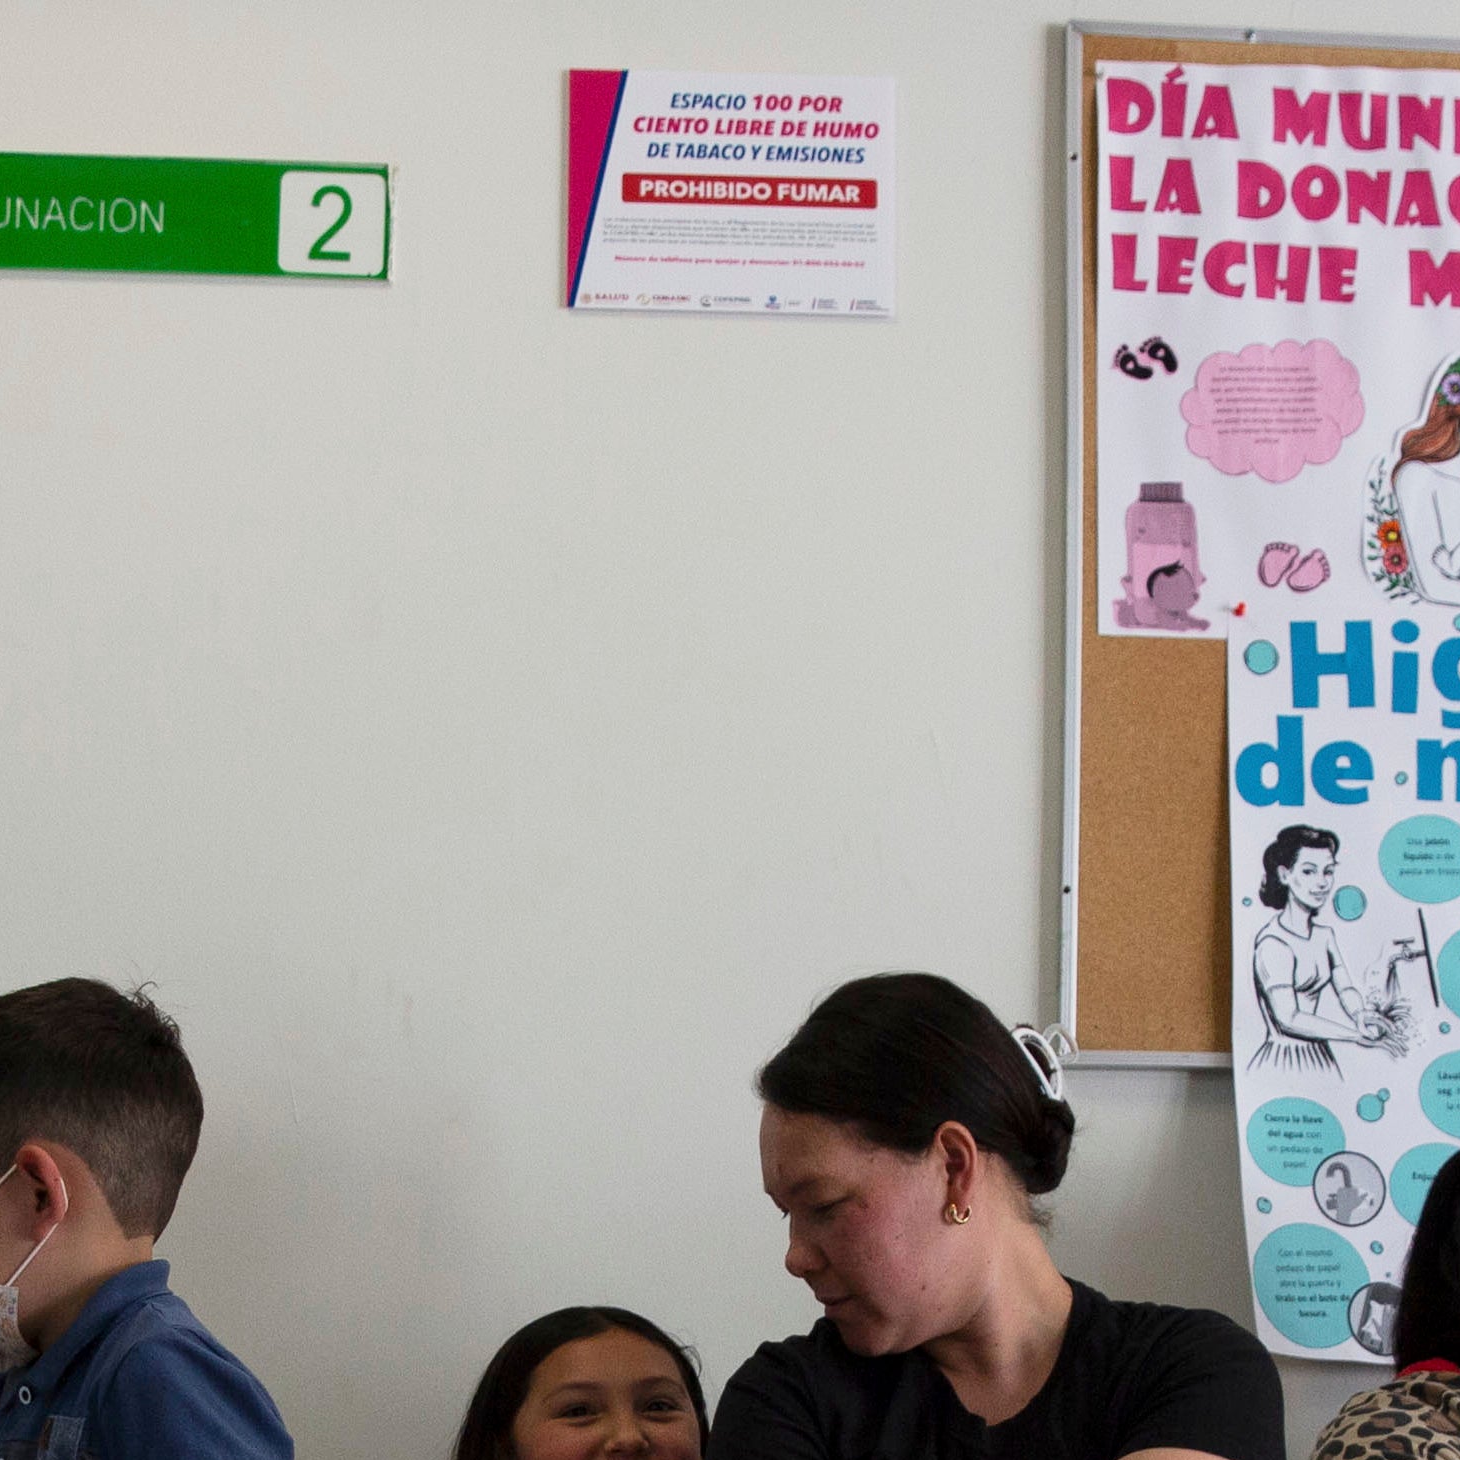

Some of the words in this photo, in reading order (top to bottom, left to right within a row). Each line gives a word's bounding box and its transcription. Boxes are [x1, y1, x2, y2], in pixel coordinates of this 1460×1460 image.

[633, 117, 708, 135] CIENTO
[715, 119, 774, 136] LIBRE
[779, 121, 807, 137] DE
[813, 121, 879, 139] HUMO
[671, 93, 746, 110] ESPACIO
[753, 95, 792, 111] 100
[798, 96, 842, 113] POR
[1106, 66, 1239, 141] DÍA
[647, 142, 671, 158] DE
[677, 143, 745, 160] TABACO
[751, 145, 762, 160] Y
[766, 146, 865, 163] EMISIONES
[640, 179, 771, 201] PROHIBIDO
[778, 181, 860, 203] FUMAR
[1109, 156, 1202, 215] LA
[308, 185, 353, 261] 2
[1111, 234, 1357, 303] LECHE
[1234, 715, 1375, 807] de
